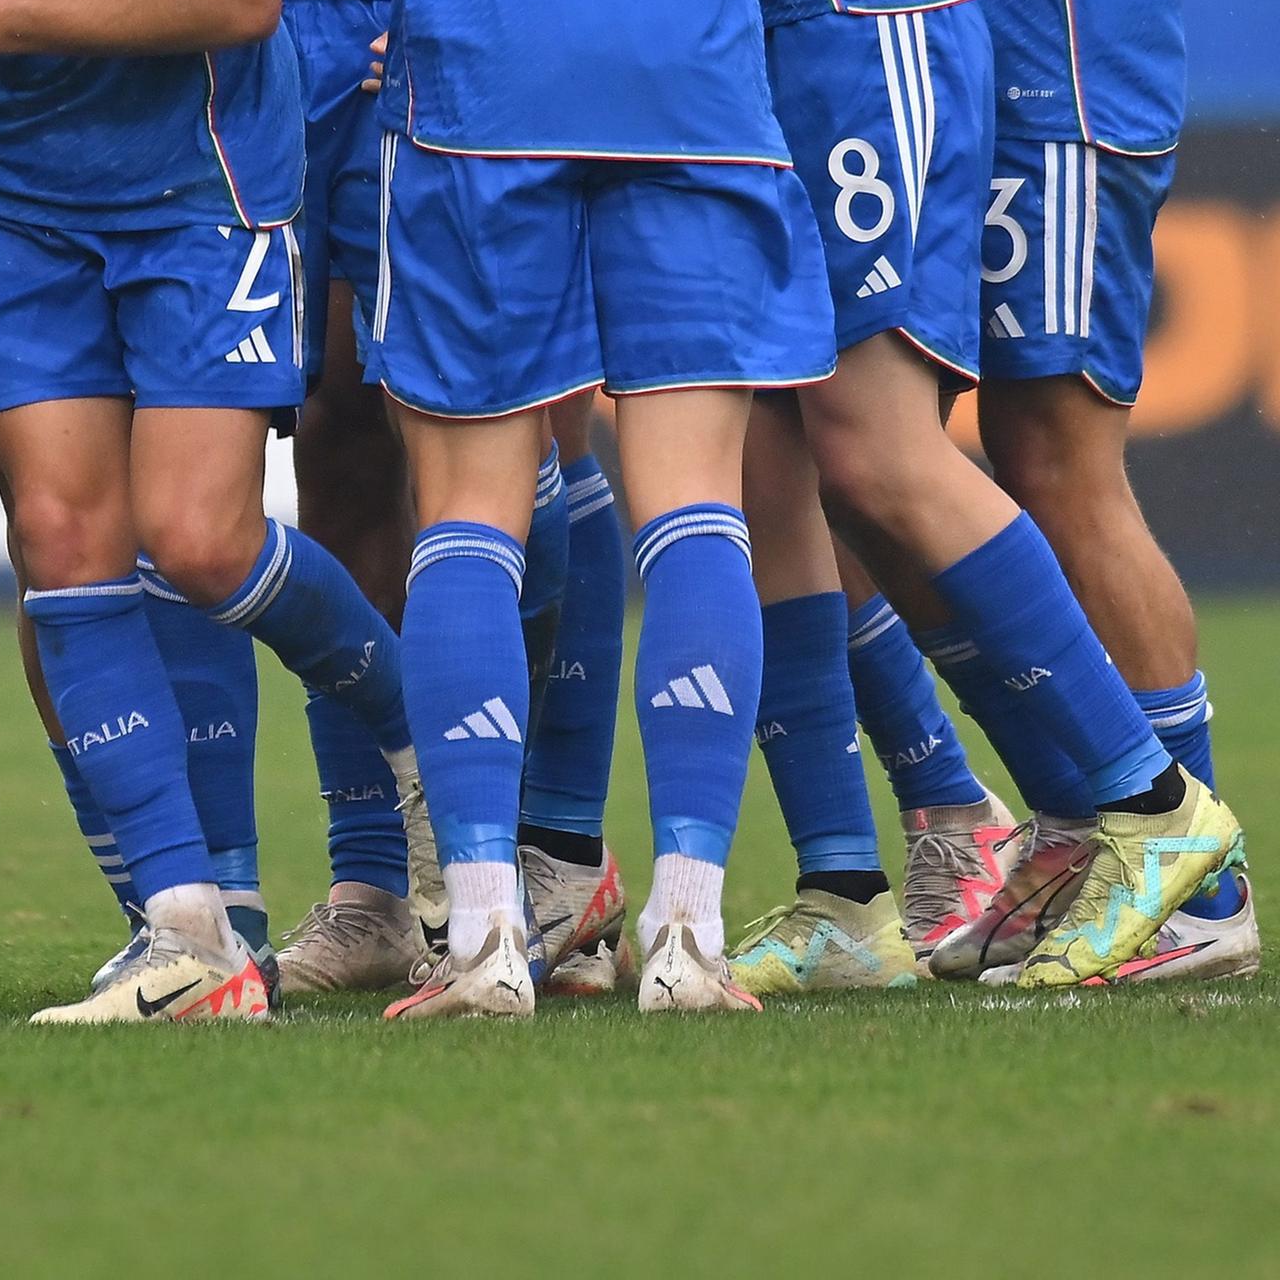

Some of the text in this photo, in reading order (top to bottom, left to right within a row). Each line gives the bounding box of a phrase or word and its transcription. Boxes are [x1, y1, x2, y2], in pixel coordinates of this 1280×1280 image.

[828, 138, 895, 243] 8
[980, 178, 1028, 284] 3
[186, 721, 237, 743] LIA
